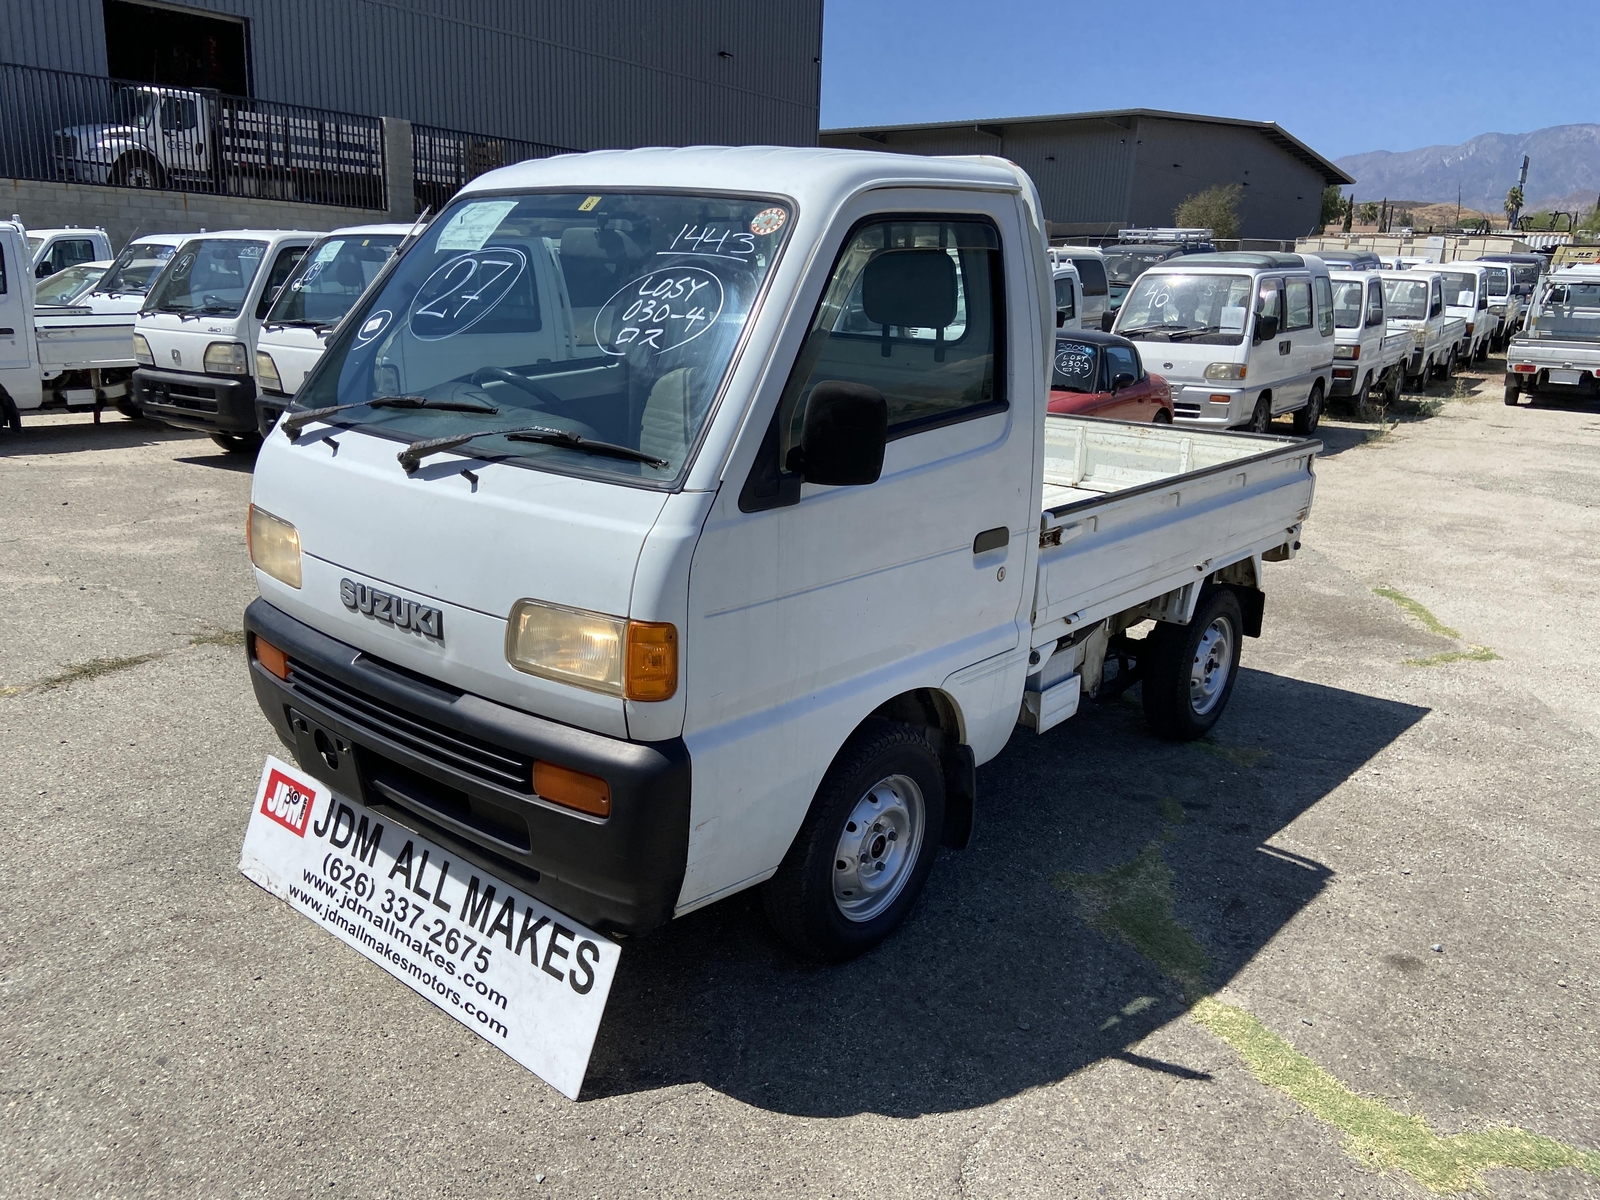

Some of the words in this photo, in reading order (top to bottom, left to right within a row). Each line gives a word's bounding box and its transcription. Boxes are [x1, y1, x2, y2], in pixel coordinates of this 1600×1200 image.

[669, 223, 755, 254] 1443
[415, 258, 514, 319] 27
[622, 299, 705, 333] 030-4
[1144, 284, 1170, 309] 46
[340, 578, 443, 641] SUZUKI
[313, 798, 385, 868] JDM
[388, 839, 452, 914] ALL
[459, 874, 601, 996] MAKES
[321, 852, 376, 903] (626)
[380, 888, 493, 974] 337-2675
[288, 883, 509, 1039] www.jdmallmakesmotors.com
[302, 867, 508, 1011] www.jdmallmakes.com
